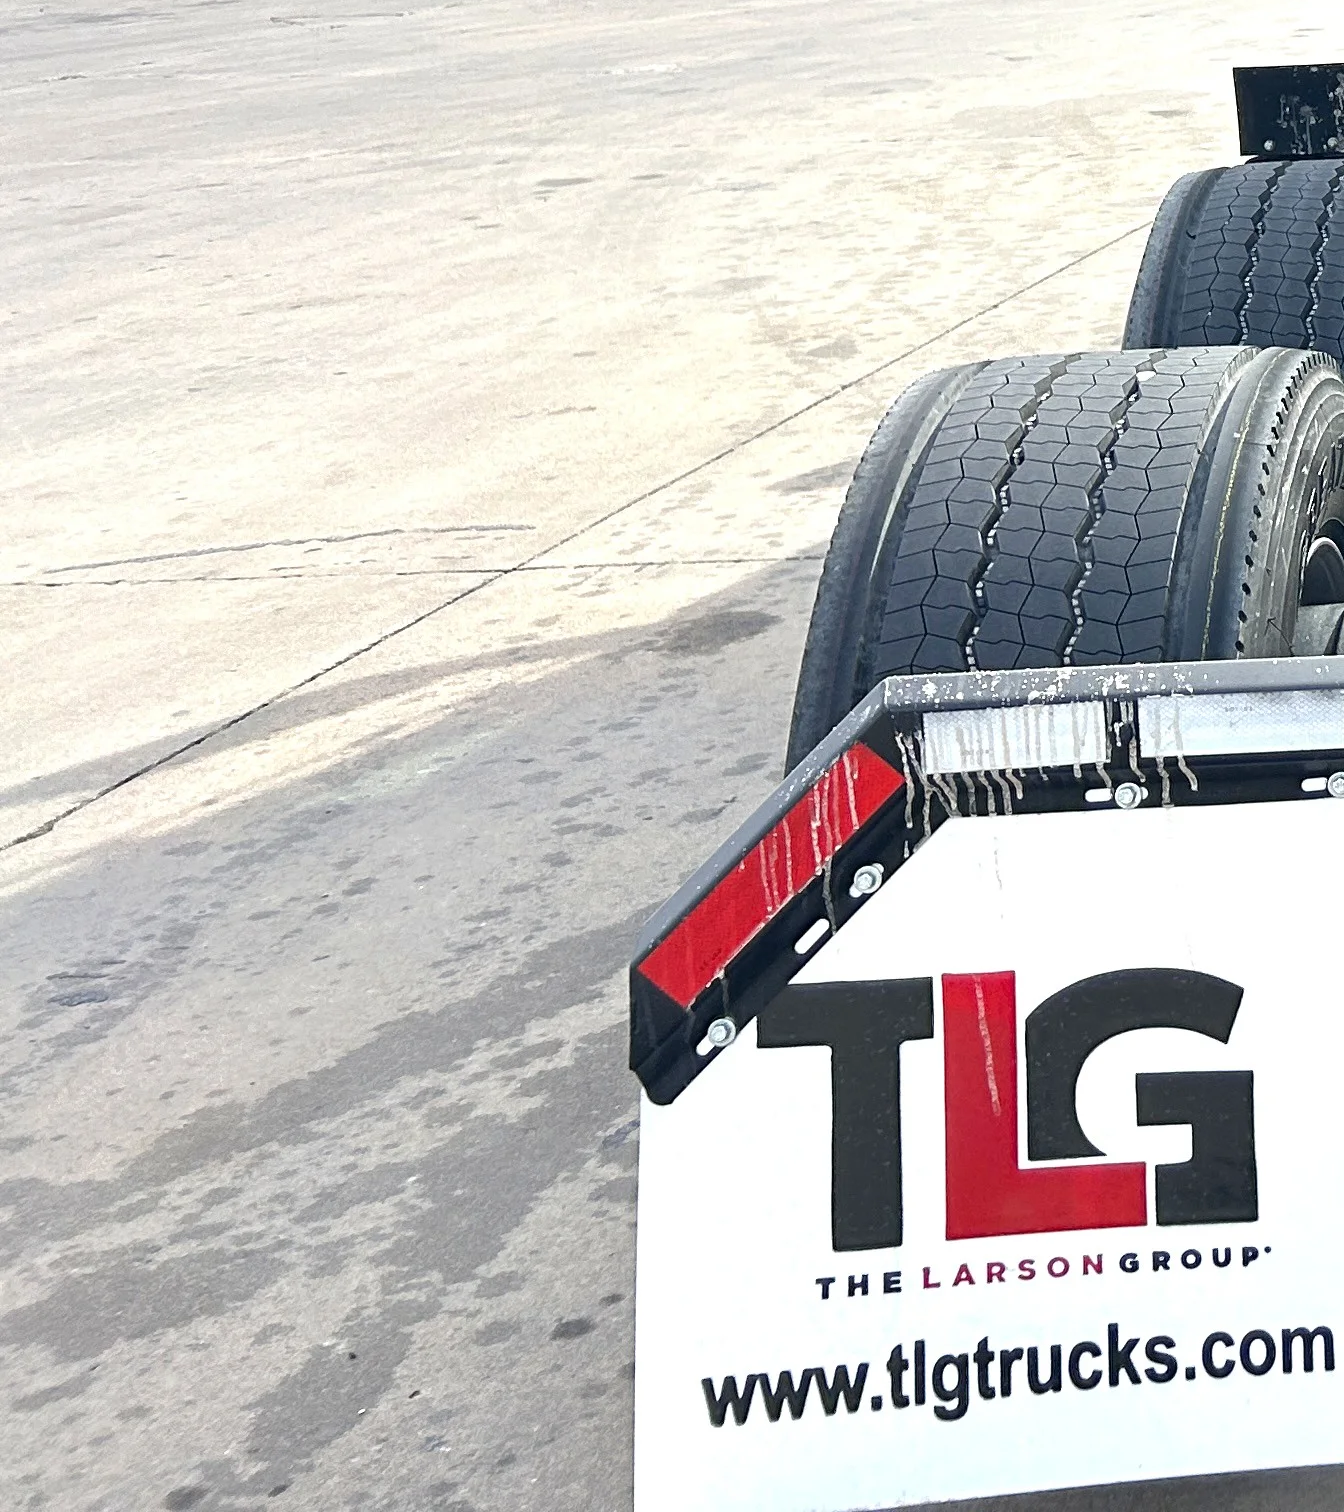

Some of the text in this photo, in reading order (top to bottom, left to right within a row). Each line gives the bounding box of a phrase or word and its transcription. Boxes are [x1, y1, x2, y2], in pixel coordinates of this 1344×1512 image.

[756, 967, 1259, 1252] TLG
[815, 1271, 903, 1301] THE
[922, 1254, 1104, 1290] LARSON
[702, 1322, 1336, 1428] www.tlgtrucks.com
